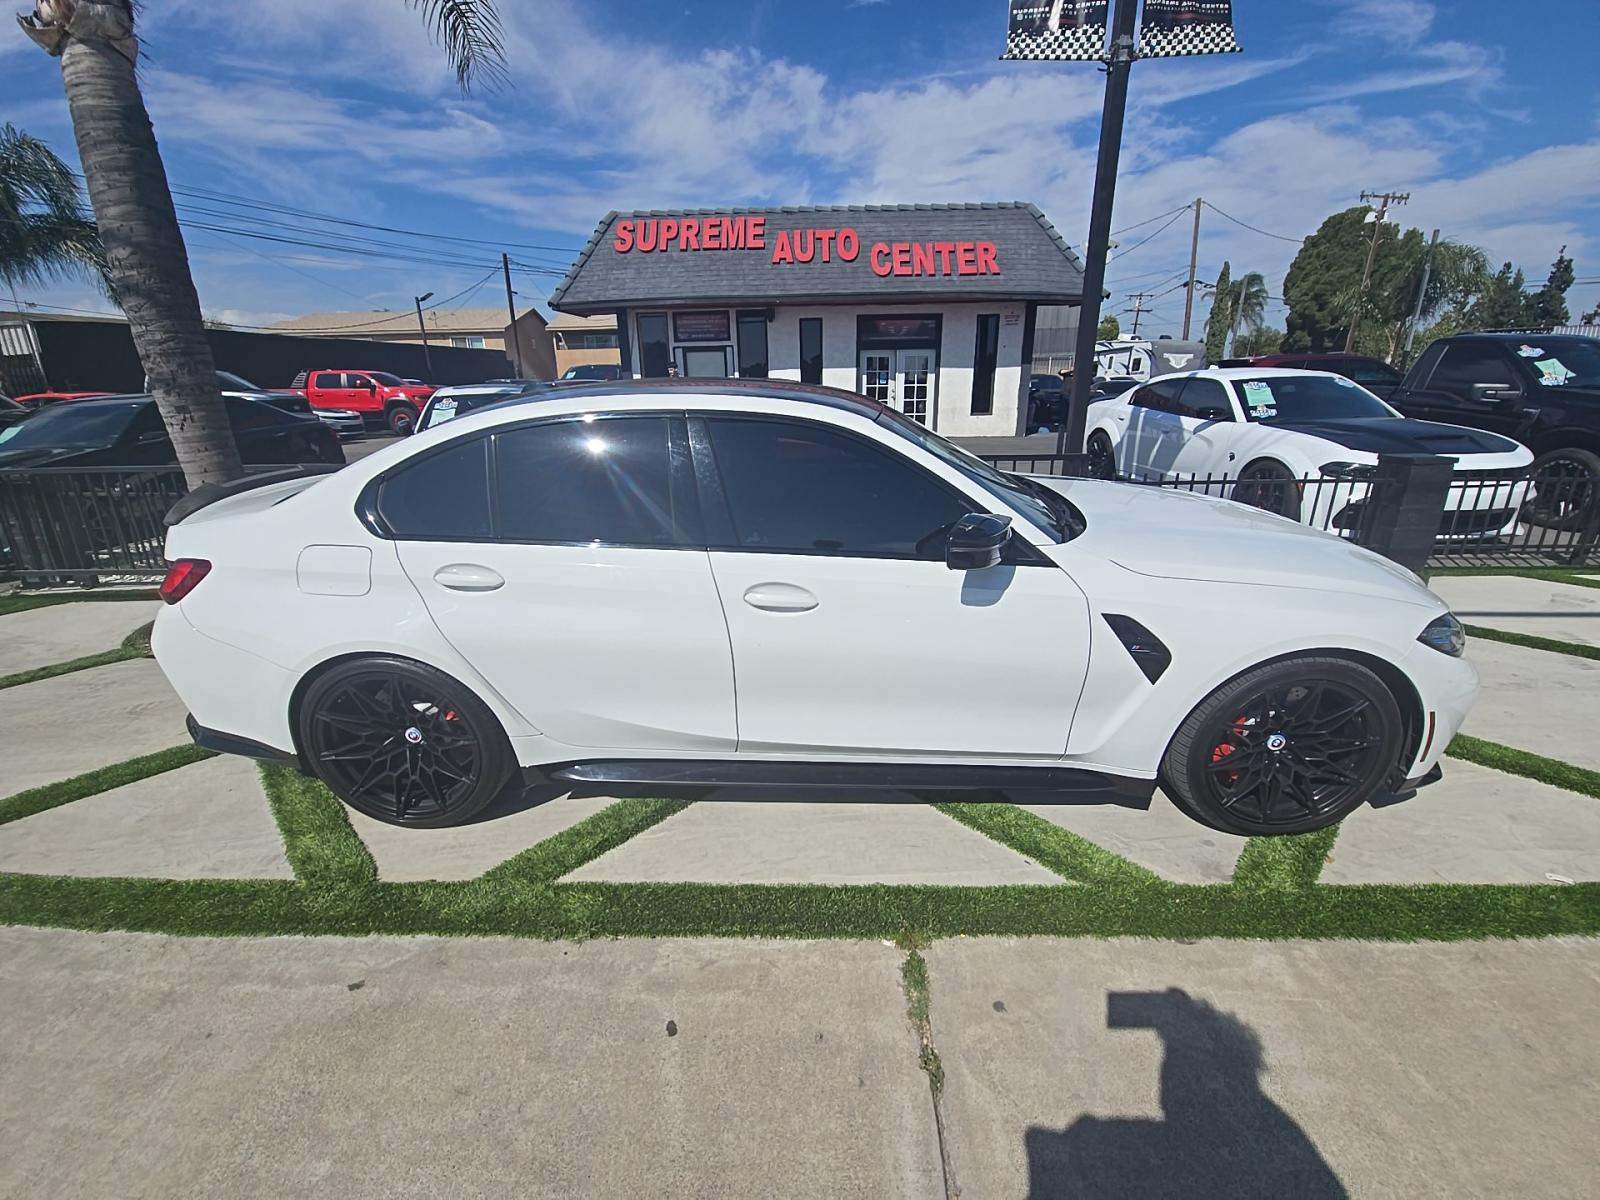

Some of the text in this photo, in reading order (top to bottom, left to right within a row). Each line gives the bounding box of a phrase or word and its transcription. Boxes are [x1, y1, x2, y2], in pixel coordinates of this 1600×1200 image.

[613, 216, 1001, 277] SUPREME AUTO CENTER
